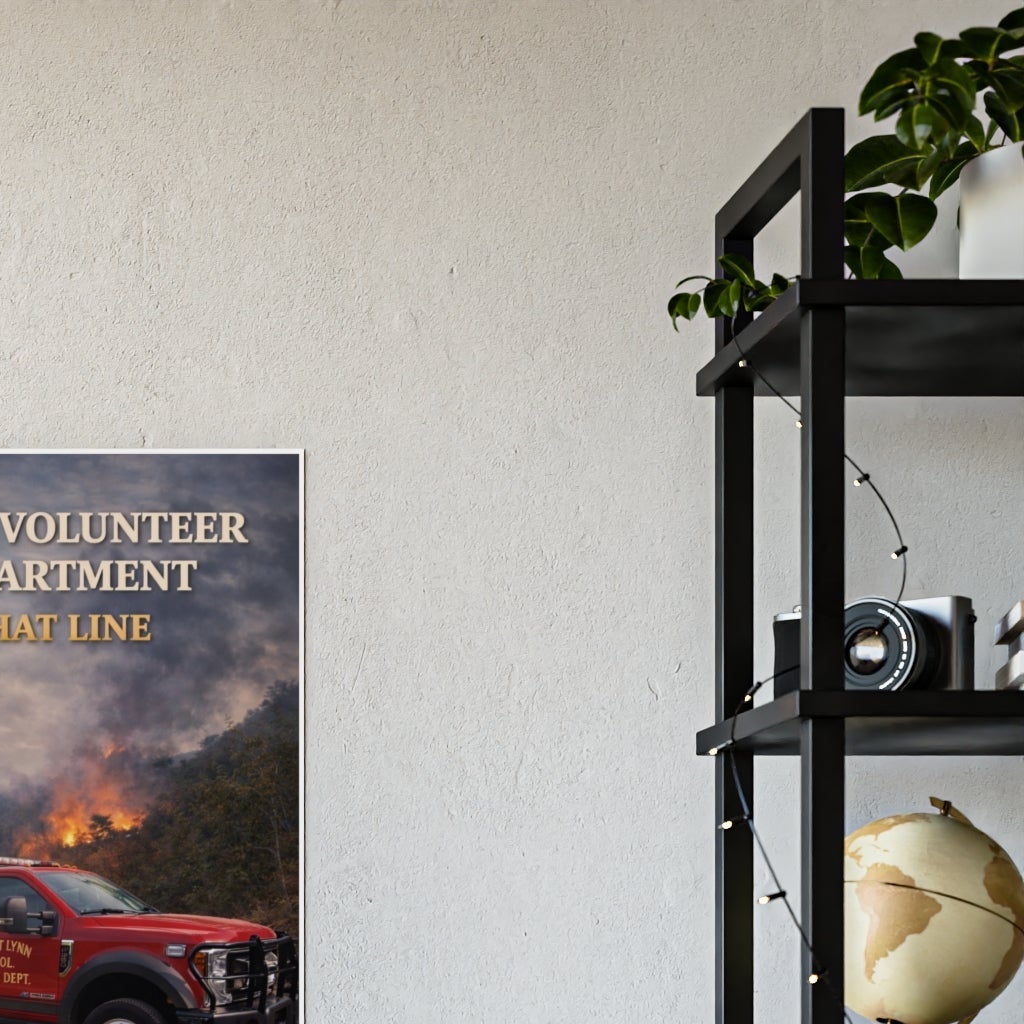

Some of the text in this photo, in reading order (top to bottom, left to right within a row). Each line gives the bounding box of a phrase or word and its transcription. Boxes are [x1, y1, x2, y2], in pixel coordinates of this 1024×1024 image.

[68, 614, 153, 643] LINE
[6, 940, 33, 959] LYNN
[3, 972, 32, 985] DEPT.
